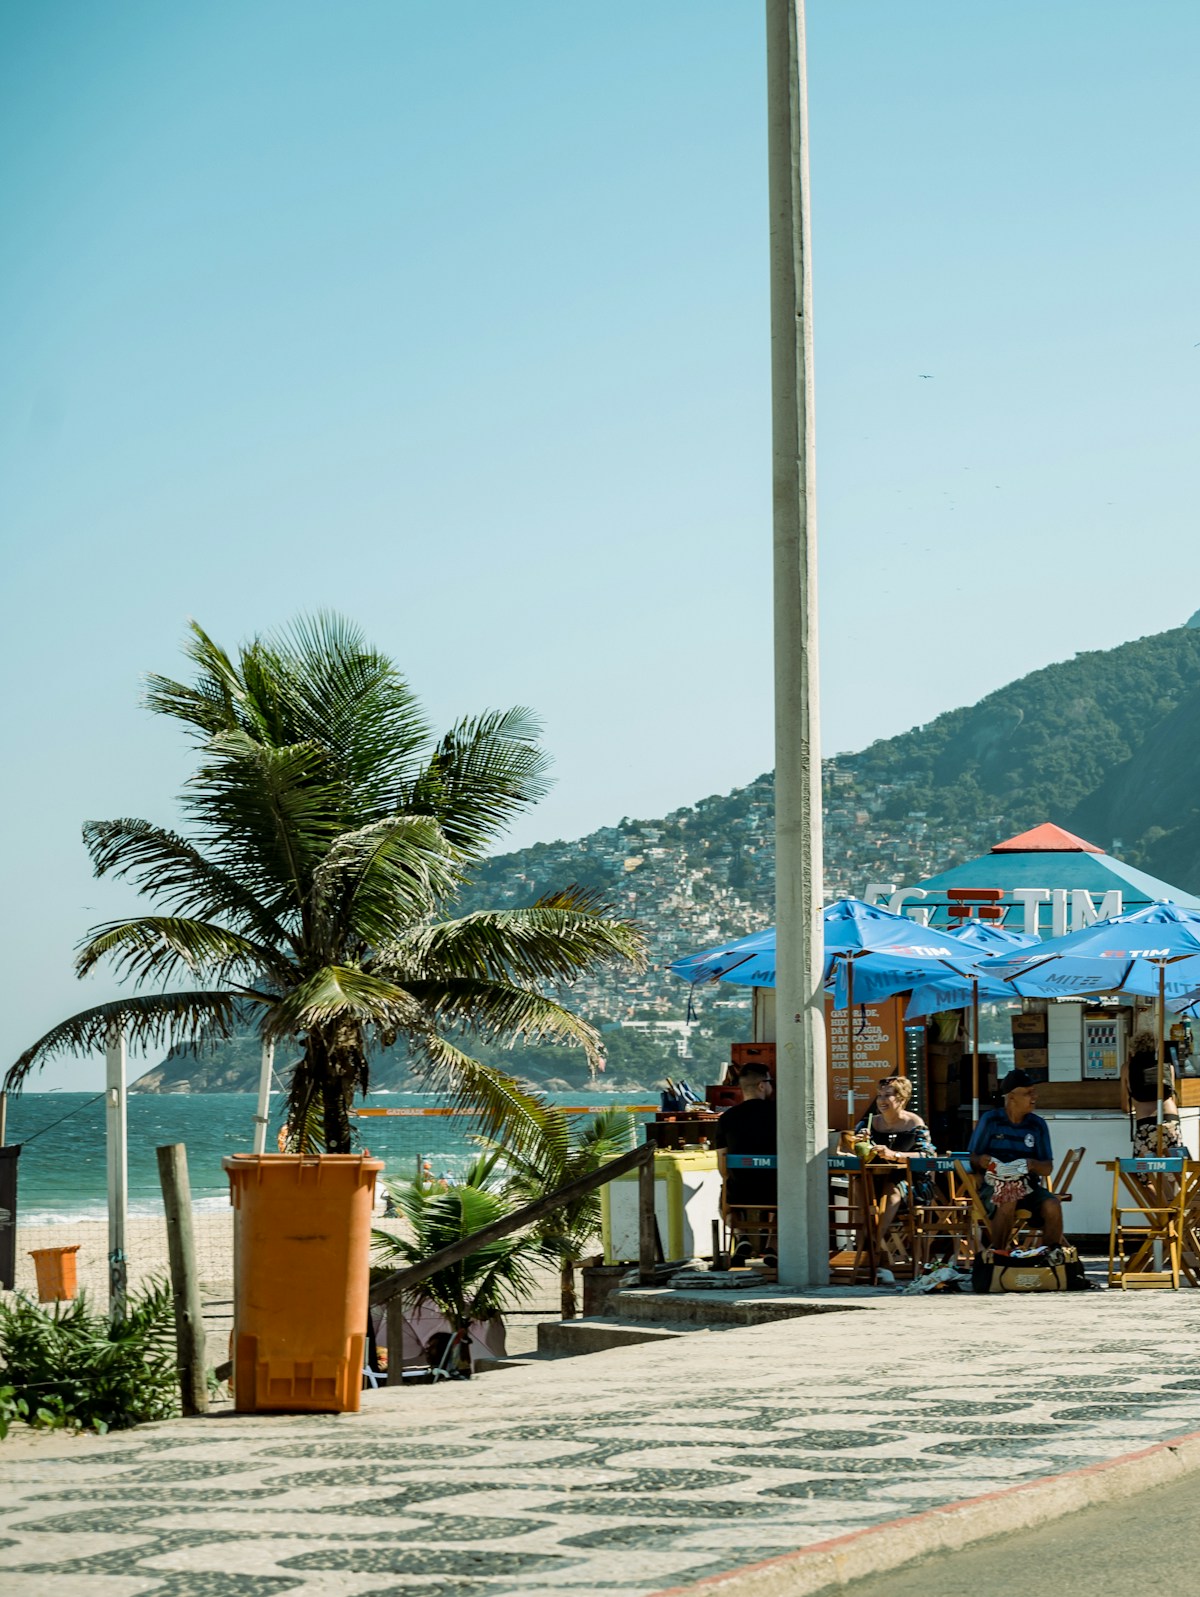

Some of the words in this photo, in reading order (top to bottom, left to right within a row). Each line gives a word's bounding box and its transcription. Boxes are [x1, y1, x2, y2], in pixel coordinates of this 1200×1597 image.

[1013, 888, 1123, 937] TIM
[1128, 948, 1171, 958] TIM
[752, 1158, 771, 1166] TIM
[827, 1159, 845, 1168] TIM
[936, 1160, 955, 1169] TIM
[1147, 1161, 1167, 1170] TIM
